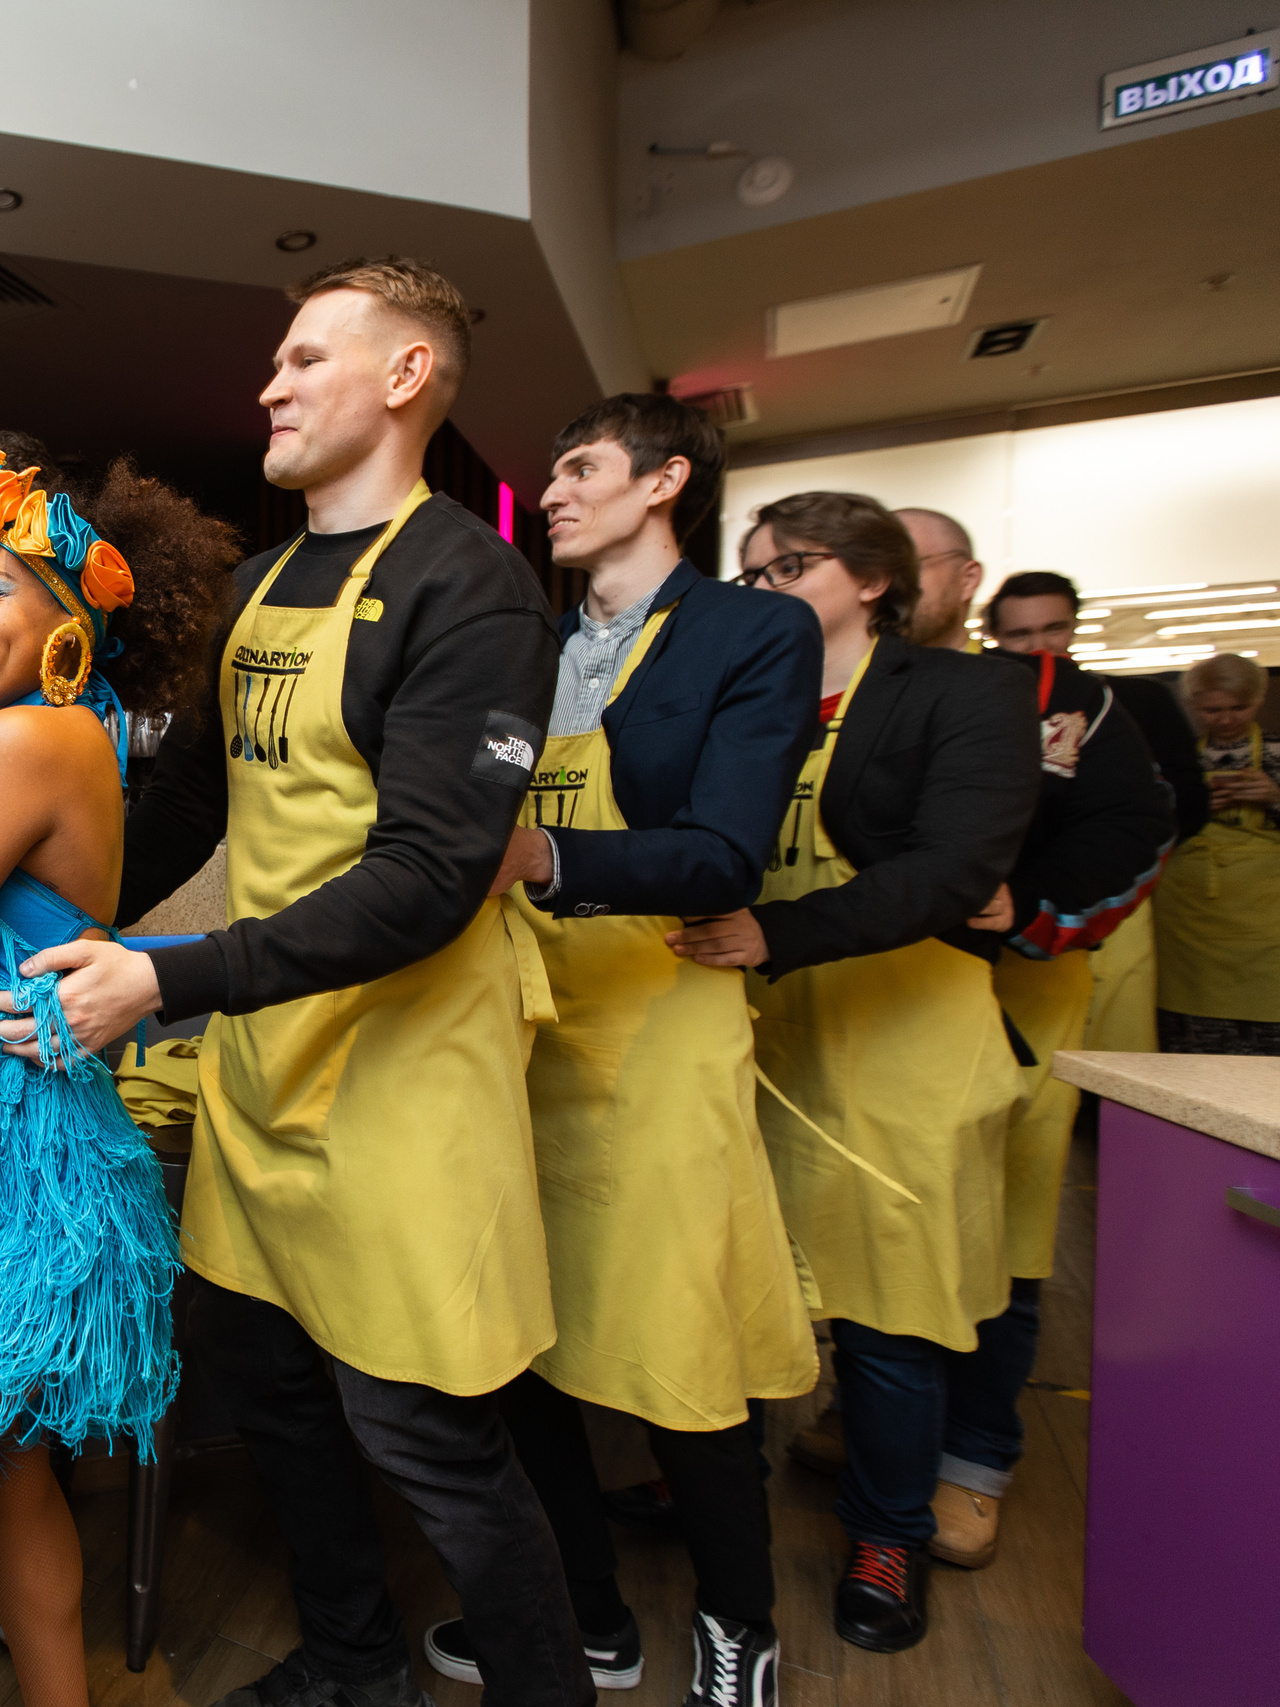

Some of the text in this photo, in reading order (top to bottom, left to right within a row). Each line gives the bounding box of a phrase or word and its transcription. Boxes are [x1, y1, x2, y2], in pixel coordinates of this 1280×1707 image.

[1118, 53, 1266, 116] ВЫХОД
[486, 740, 524, 759] NORTH
[507, 736, 527, 749] THE
[495, 751, 522, 766] FACE
